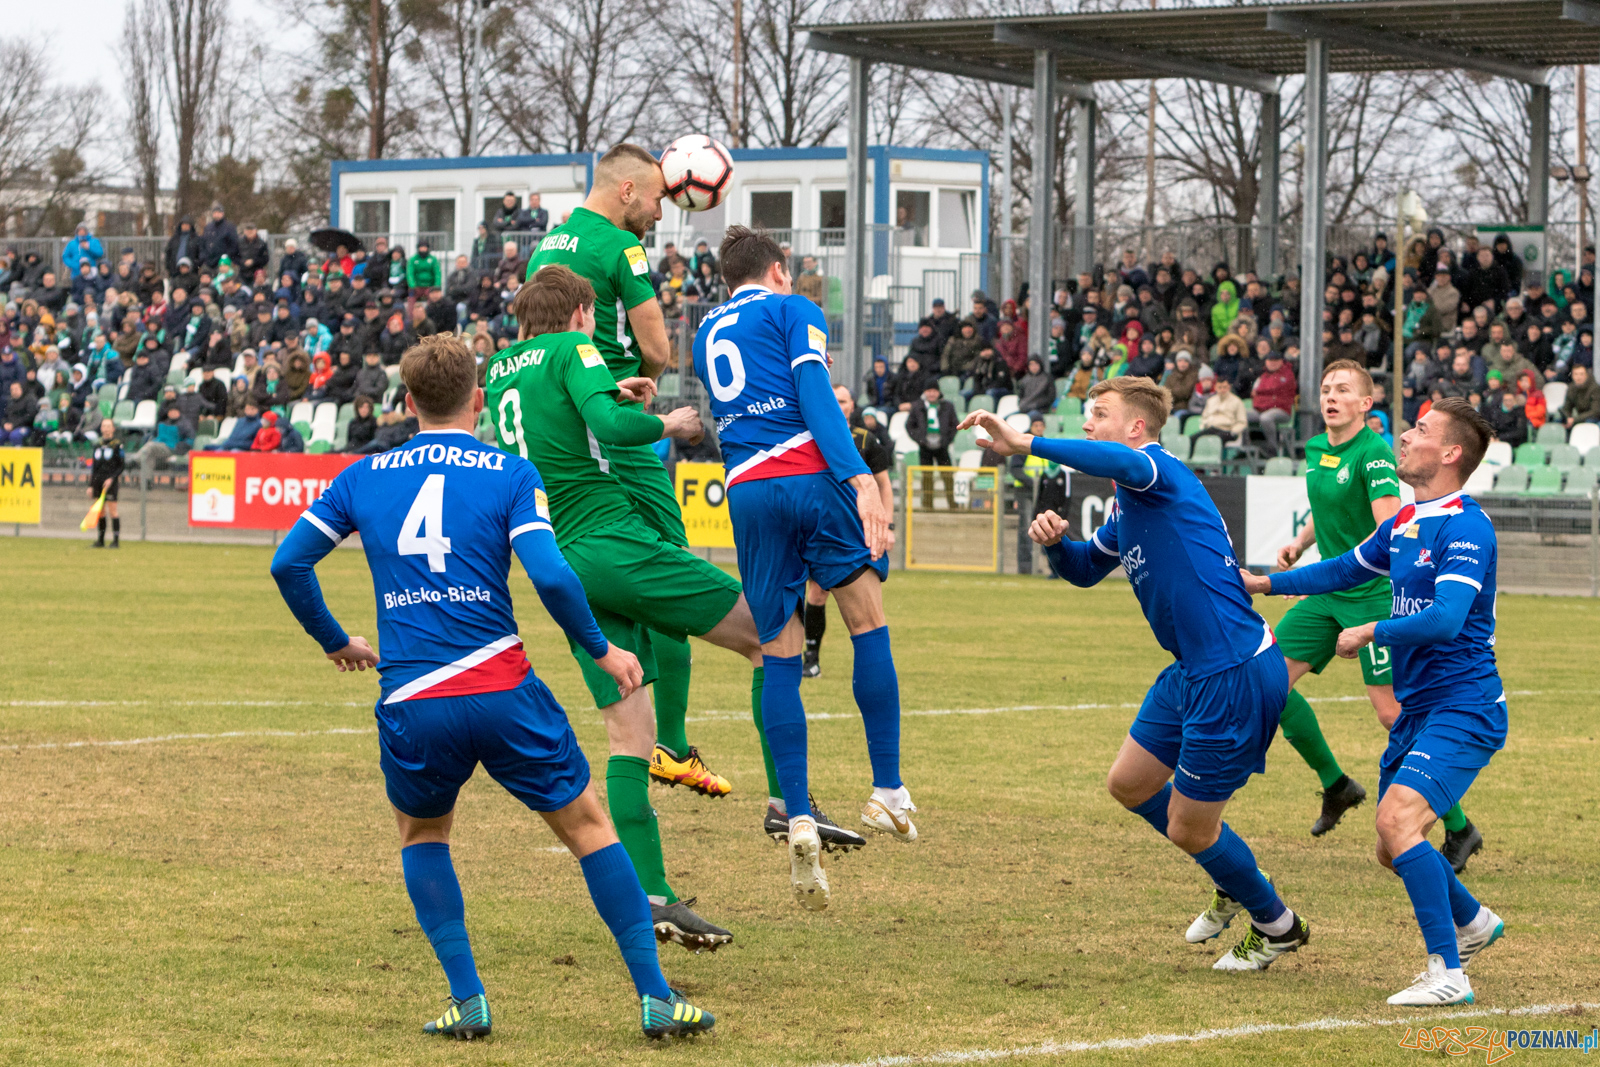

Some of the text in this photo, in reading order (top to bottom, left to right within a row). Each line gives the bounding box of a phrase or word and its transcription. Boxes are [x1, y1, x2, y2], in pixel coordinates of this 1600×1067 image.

[706, 312, 746, 402] 6
[371, 444, 506, 471] WIKTORSKI
[498, 388, 528, 460] 9
[397, 474, 452, 573] 4
[384, 586, 491, 610] Bielsko-Biała
